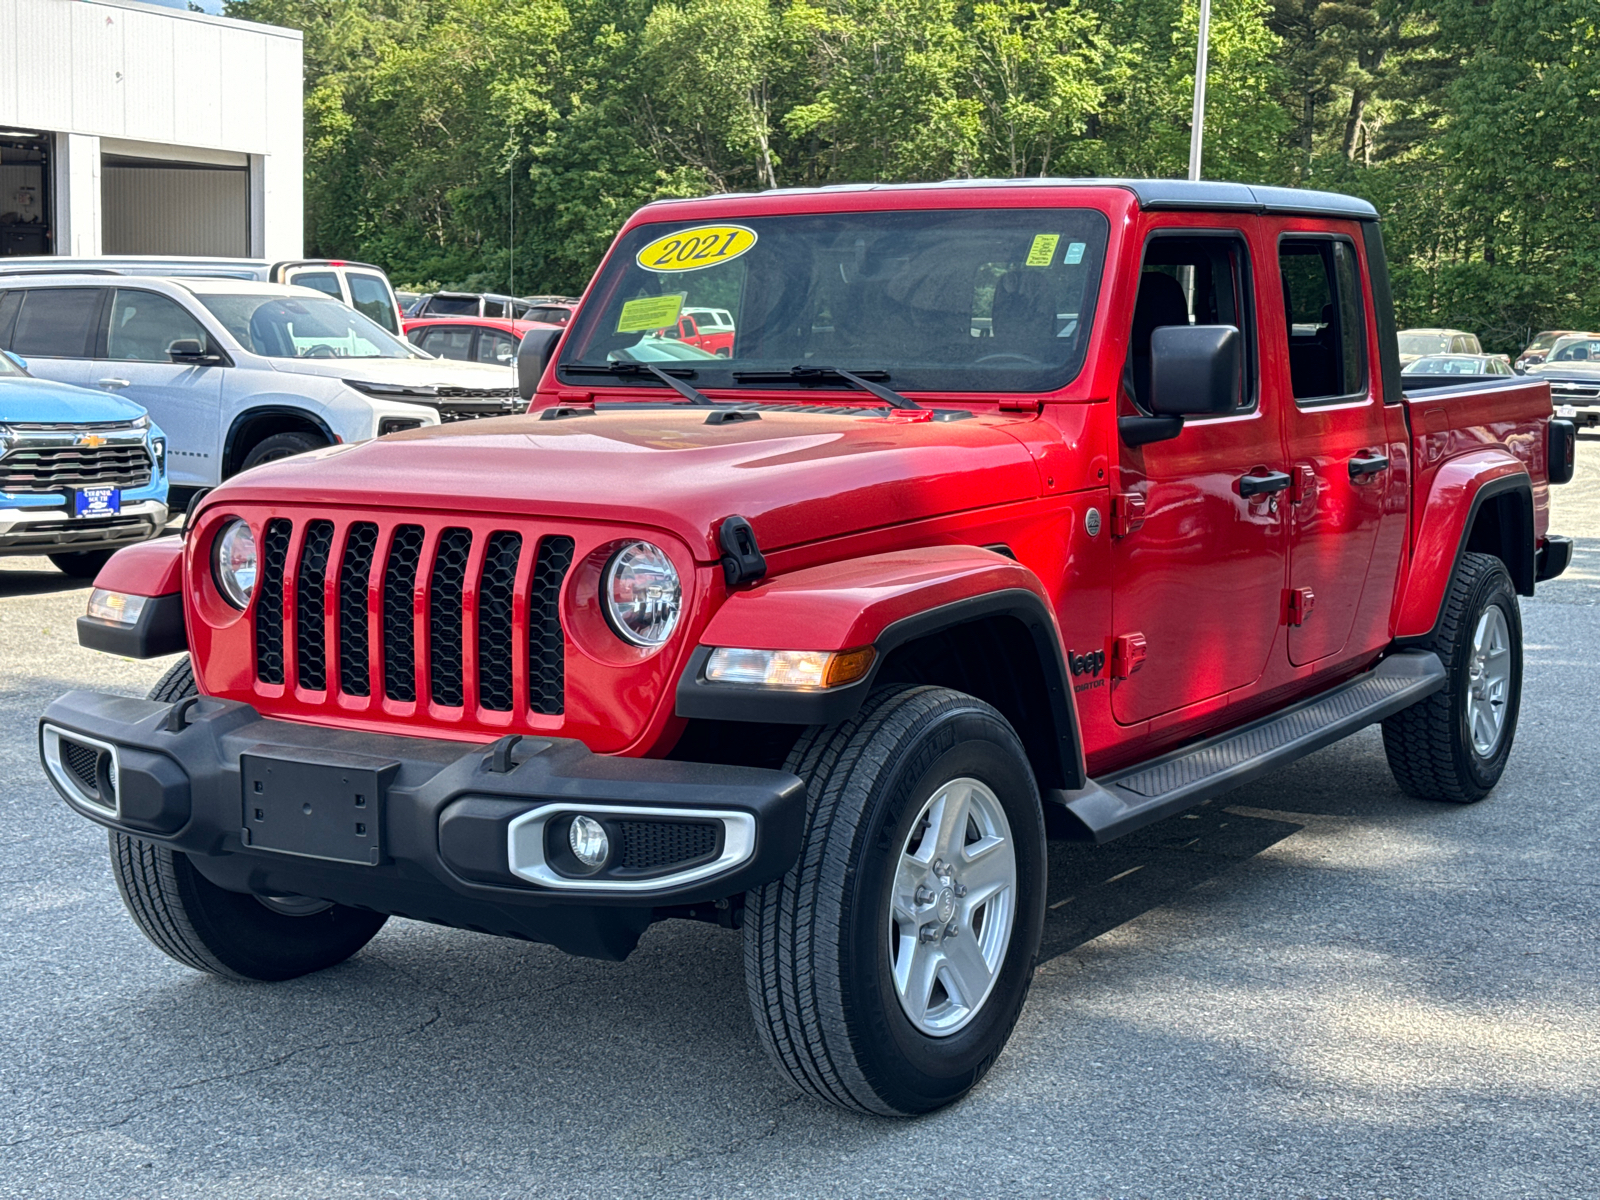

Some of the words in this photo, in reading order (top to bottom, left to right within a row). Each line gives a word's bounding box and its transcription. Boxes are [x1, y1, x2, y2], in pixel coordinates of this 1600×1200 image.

[653, 231, 740, 266] 2021
[167, 450, 209, 458] AVERSE
[1074, 679, 1105, 692] DIATOR
[890, 726, 954, 822] MICHELIN
